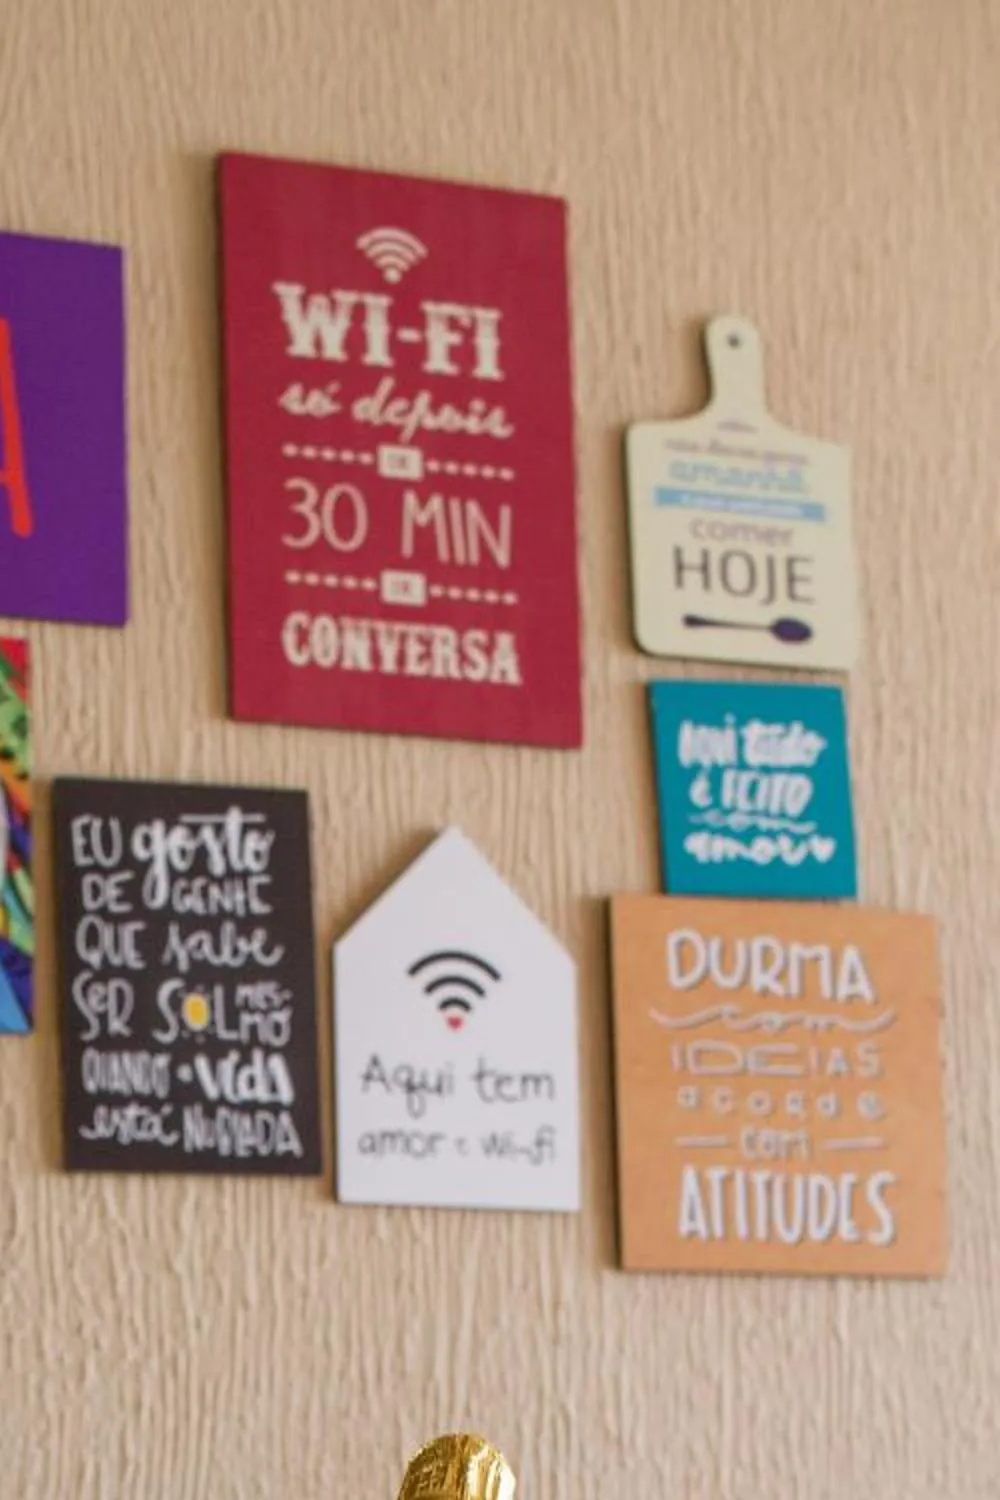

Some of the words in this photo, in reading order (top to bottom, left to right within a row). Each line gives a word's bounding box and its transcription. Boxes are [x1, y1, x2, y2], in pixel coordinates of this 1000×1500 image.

[272, 282, 505, 381] WI-FI
[352, 376, 515, 441] depois
[282, 478, 368, 553] 30
[401, 488, 511, 570] MIN
[673, 545, 815, 606] HOJE
[282, 612, 522, 685] CONVERSA
[70, 814, 122, 867] EU
[131, 805, 276, 909] gosto
[81, 871, 135, 913] DE
[172, 874, 273, 914] GENTE
[74, 915, 146, 970] QUE
[161, 920, 284, 973] sabe
[667, 928, 875, 1003] DURMA
[81, 1048, 171, 1099] QUANDO
[360, 1053, 455, 1119] Aqui
[471, 1056, 555, 1102] tem
[671, 1038, 883, 1080] IDEIAS
[357, 1130, 443, 1159] amor
[678, 1162, 896, 1247] ATITUDES
